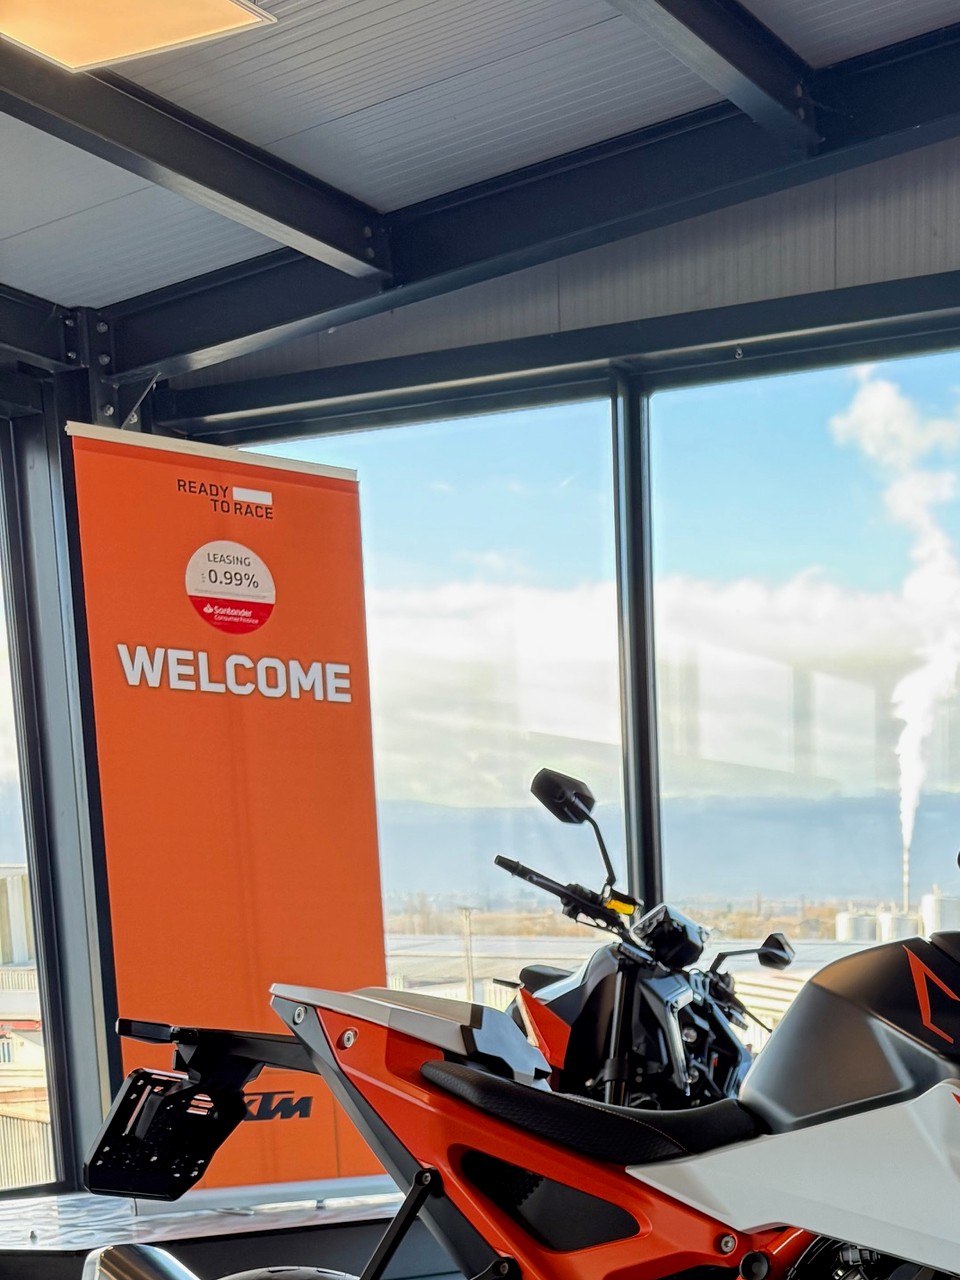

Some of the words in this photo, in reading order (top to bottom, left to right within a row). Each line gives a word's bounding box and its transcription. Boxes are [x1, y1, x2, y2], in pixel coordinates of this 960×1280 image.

[177, 479, 229, 498] READY
[210, 498, 230, 513] TO
[234, 503, 274, 519] RACE
[207, 552, 251, 567] LEASING
[208, 569, 259, 589] 0.99%
[213, 605, 252, 617] Santander
[117, 643, 352, 703] WELCOME
